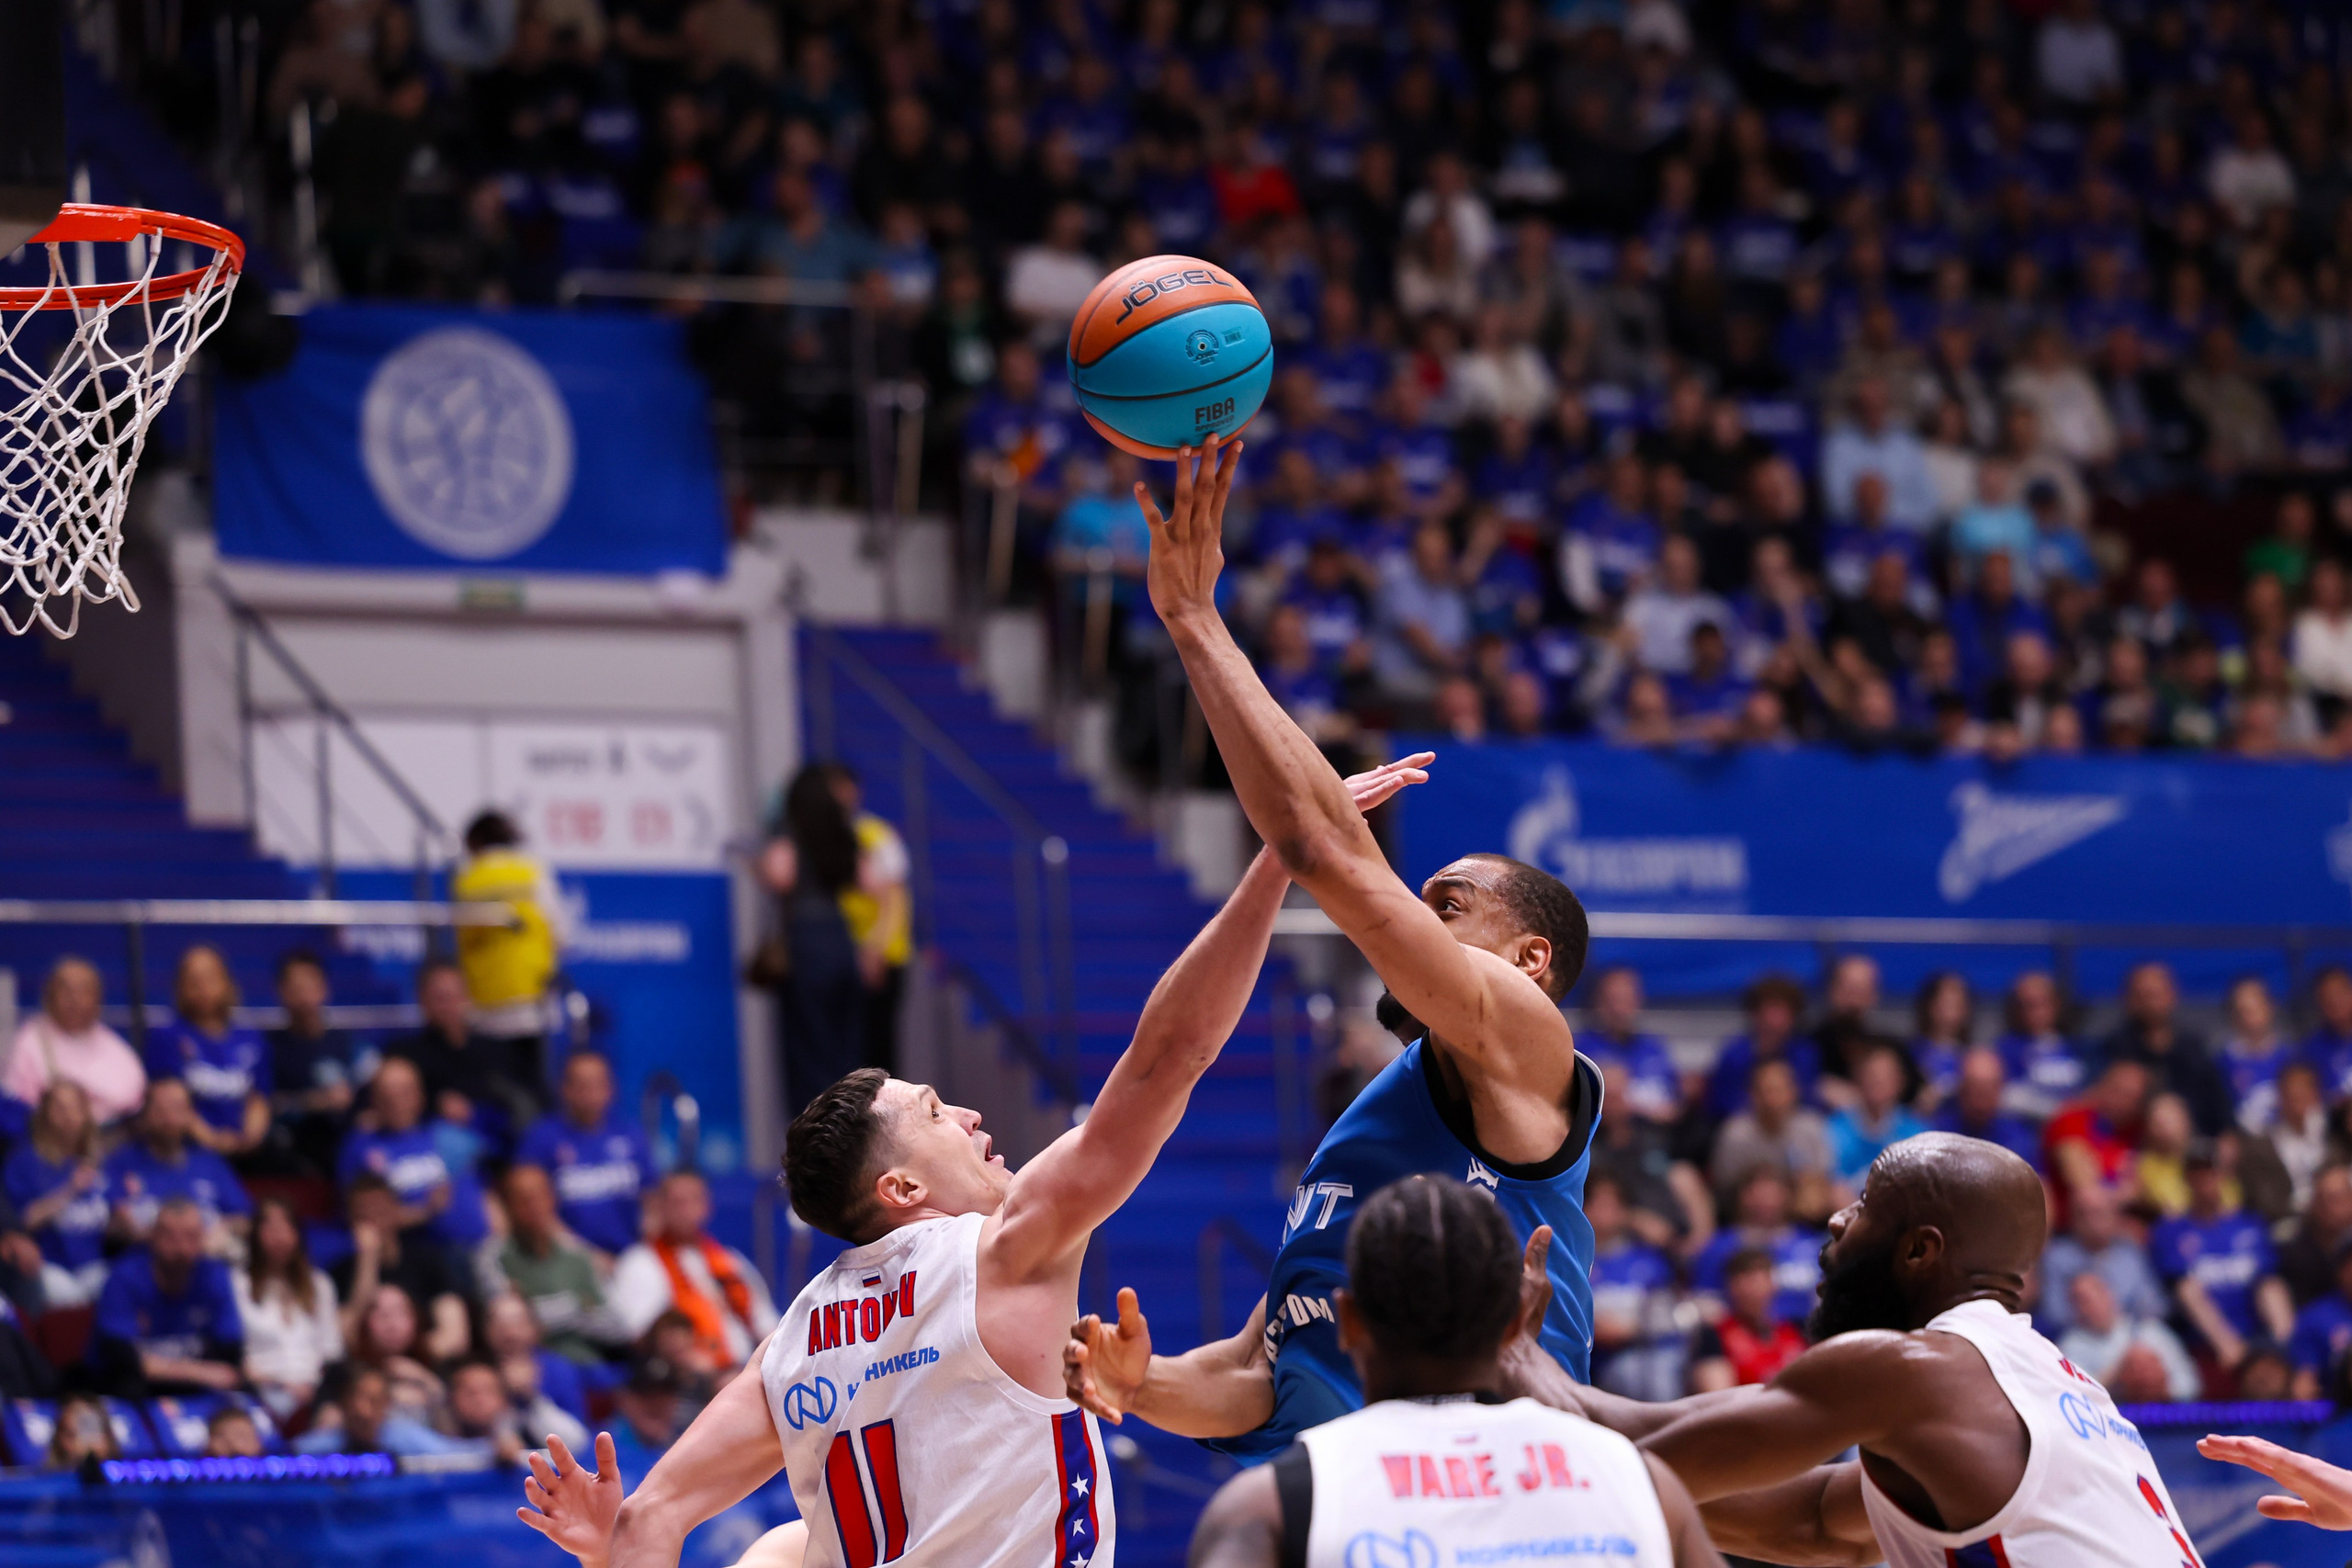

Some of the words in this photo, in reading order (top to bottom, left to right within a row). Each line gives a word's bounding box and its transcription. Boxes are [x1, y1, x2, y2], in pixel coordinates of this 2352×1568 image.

[1115, 269, 1233, 326] JÖGEL
[1194, 397, 1235, 425] FIBA
[825, 1417, 910, 1568] 11
[1380, 1453, 1502, 1500] WARE
[1516, 1442, 1591, 1492] JR.
